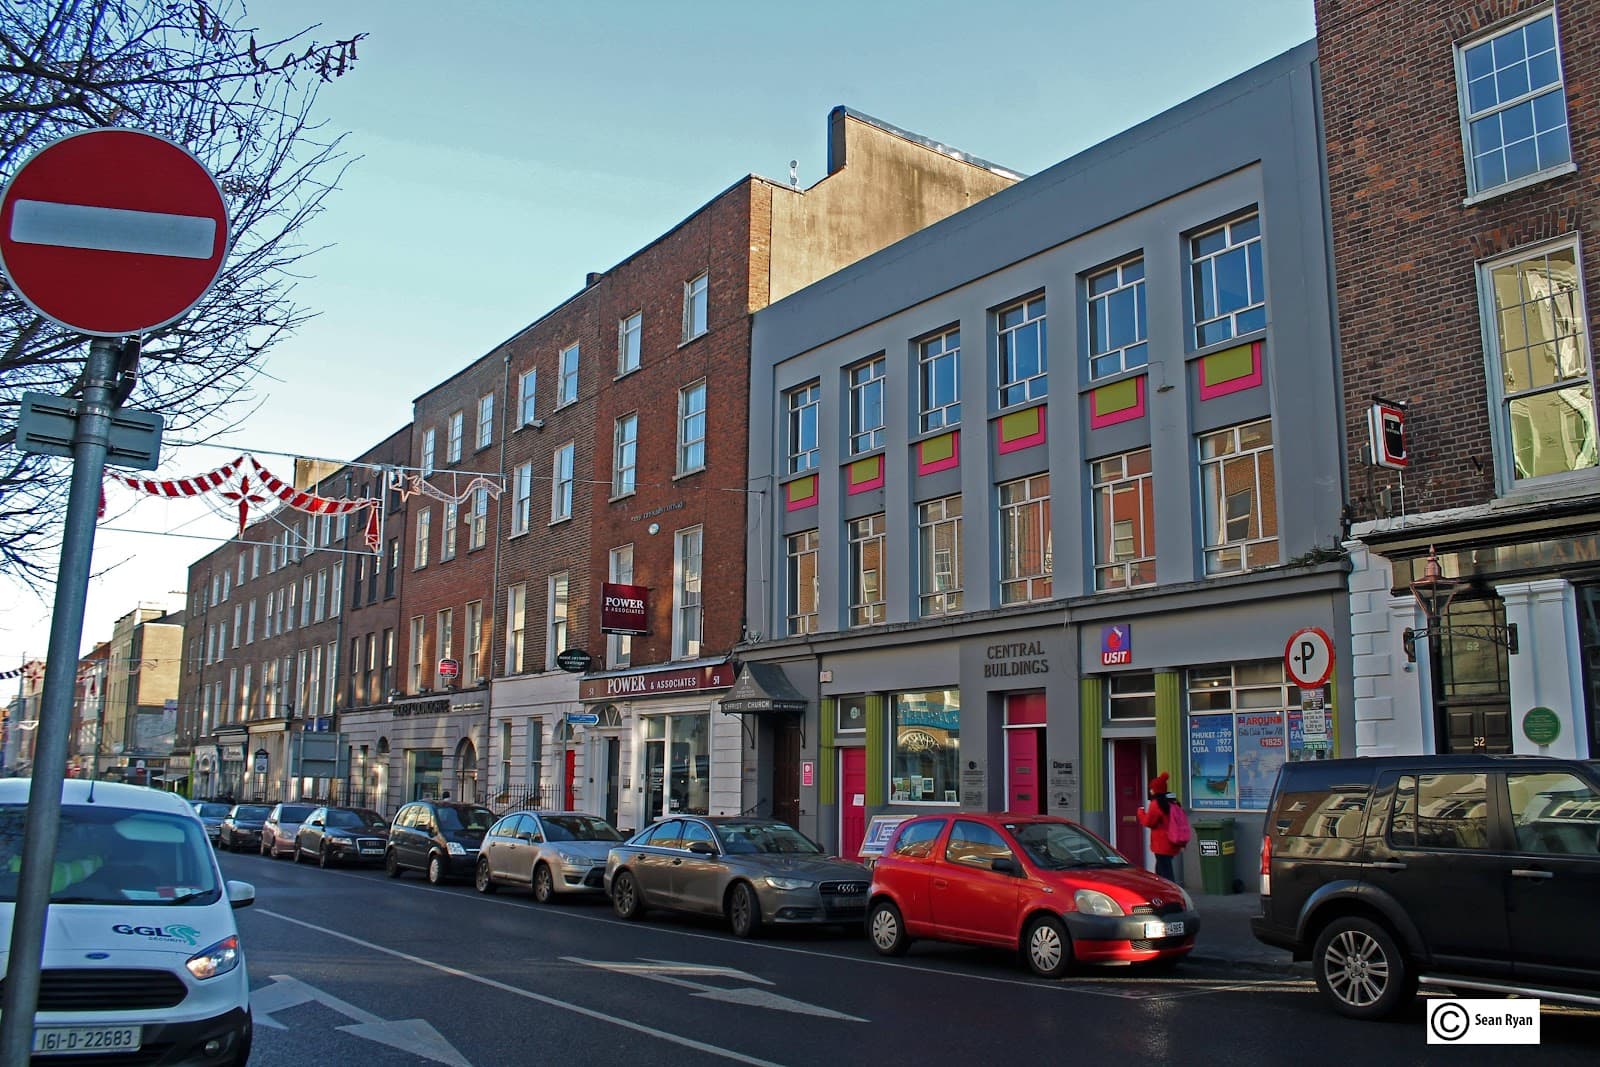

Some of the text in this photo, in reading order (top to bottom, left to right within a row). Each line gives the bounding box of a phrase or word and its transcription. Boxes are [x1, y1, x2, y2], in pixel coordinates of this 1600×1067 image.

[605, 597, 644, 609] POWER
[611, 607, 645, 615] ASSOCIATES
[987, 641, 1046, 660] CENTRAL
[1466, 641, 1480, 651] 52
[1103, 651, 1128, 665] USIT
[1301, 641, 1314, 674] P
[984, 659, 1049, 679] BUILDINGS
[607, 675, 696, 694] POWER & ASSOCIATES
[724, 702, 742, 711] CHRIST
[747, 700, 770, 709] CHURCH
[1247, 715, 1282, 726] AROUND
[1192, 731, 1215, 739] PHUKET
[1474, 737, 1485, 747] 52
[112, 924, 172, 938] GGL
[148, 936, 187, 944] SECURITY
[41, 1030, 132, 1050] 161-D-22683
